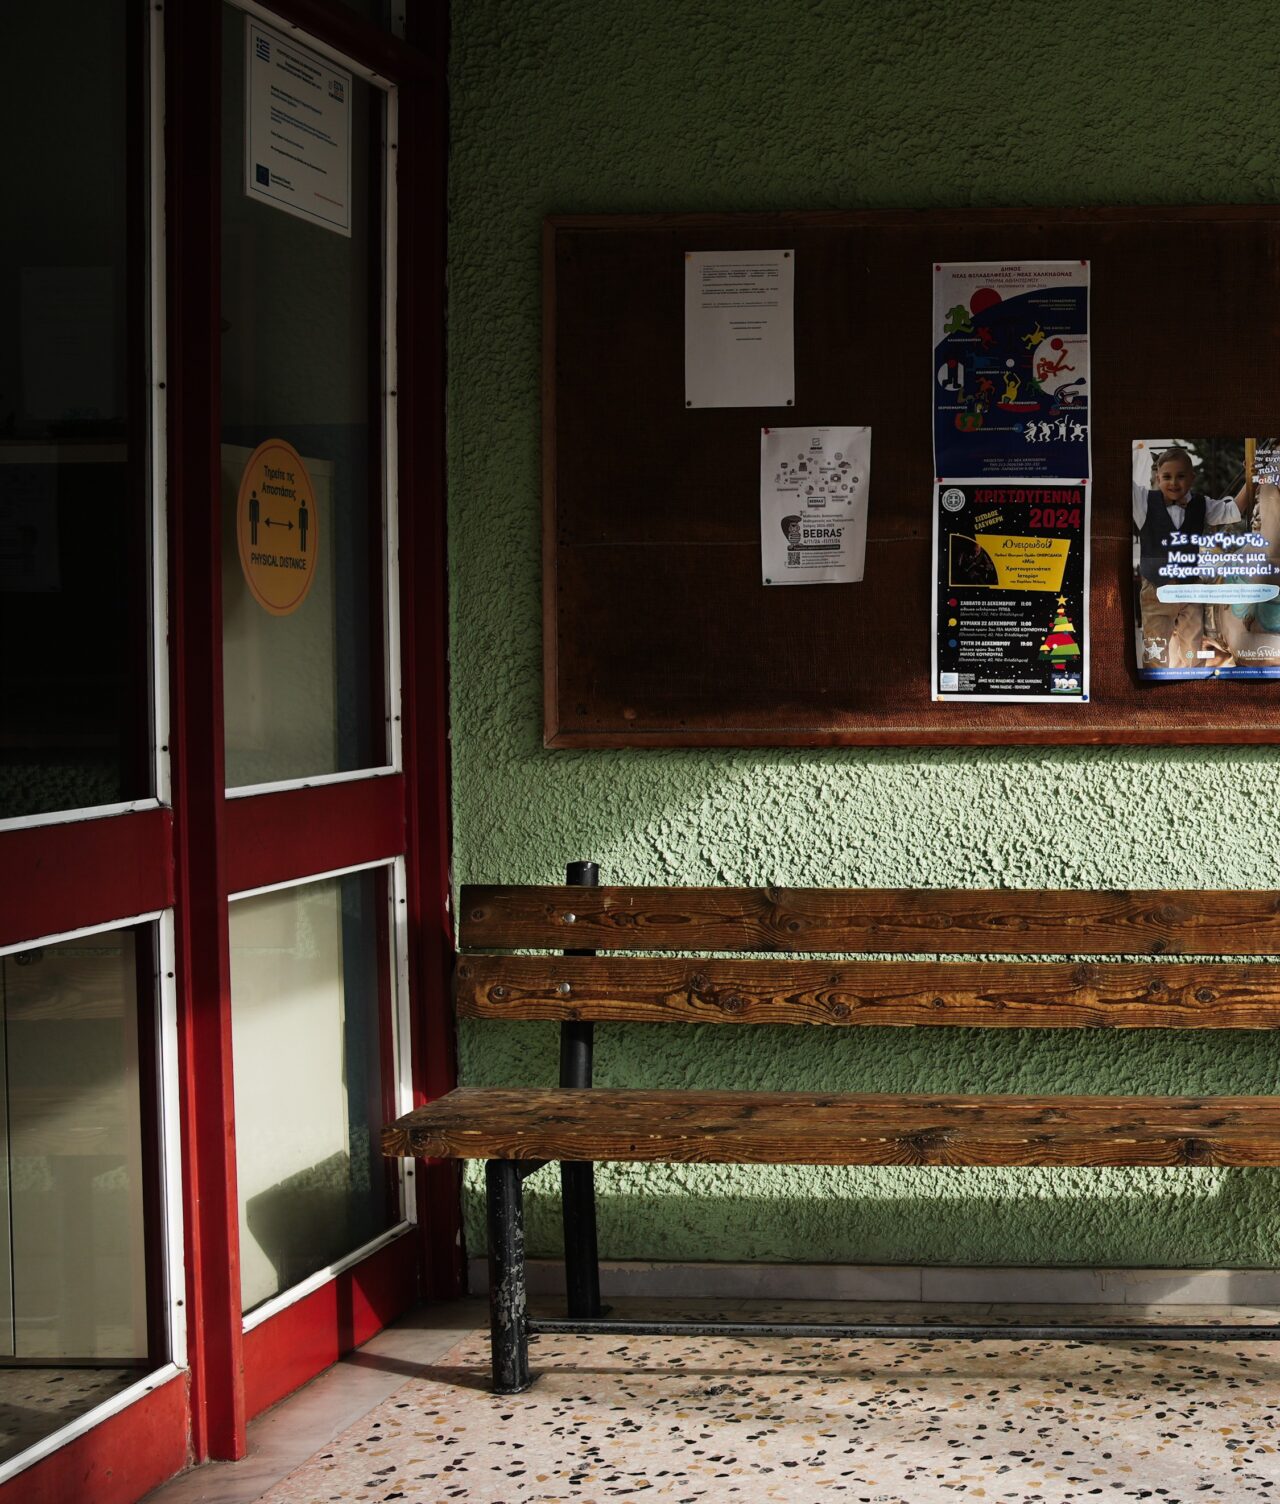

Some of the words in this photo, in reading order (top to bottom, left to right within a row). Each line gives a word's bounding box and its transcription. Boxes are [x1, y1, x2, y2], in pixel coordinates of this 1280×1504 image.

[1259, 465, 1278, 474] πάλι
[286, 472, 295, 485] τις
[1252, 474, 1280, 486] παιδί!
[262, 482, 296, 501] Αποστάσεις
[975, 488, 1082, 504] ΧΡΙΣΤΟΥΓΕΝΝΑ
[974, 510, 1000, 522] ΕΙΣΟΔΟΣ
[1029, 508, 1080, 528] 2024
[1170, 532, 1188, 546] Σε
[1190, 532, 1270, 549] ευχαριστώ.
[251, 552, 278, 568] PHYSICAL
[280, 556, 307, 570] DISTANCE
[1168, 551, 1196, 563] Μου
[1198, 552, 1244, 564] χάρισες
[1246, 553, 1266, 564] μια
[1158, 564, 1215, 578] αξέχαστη
[1216, 564, 1272, 576] εμπειρία!
